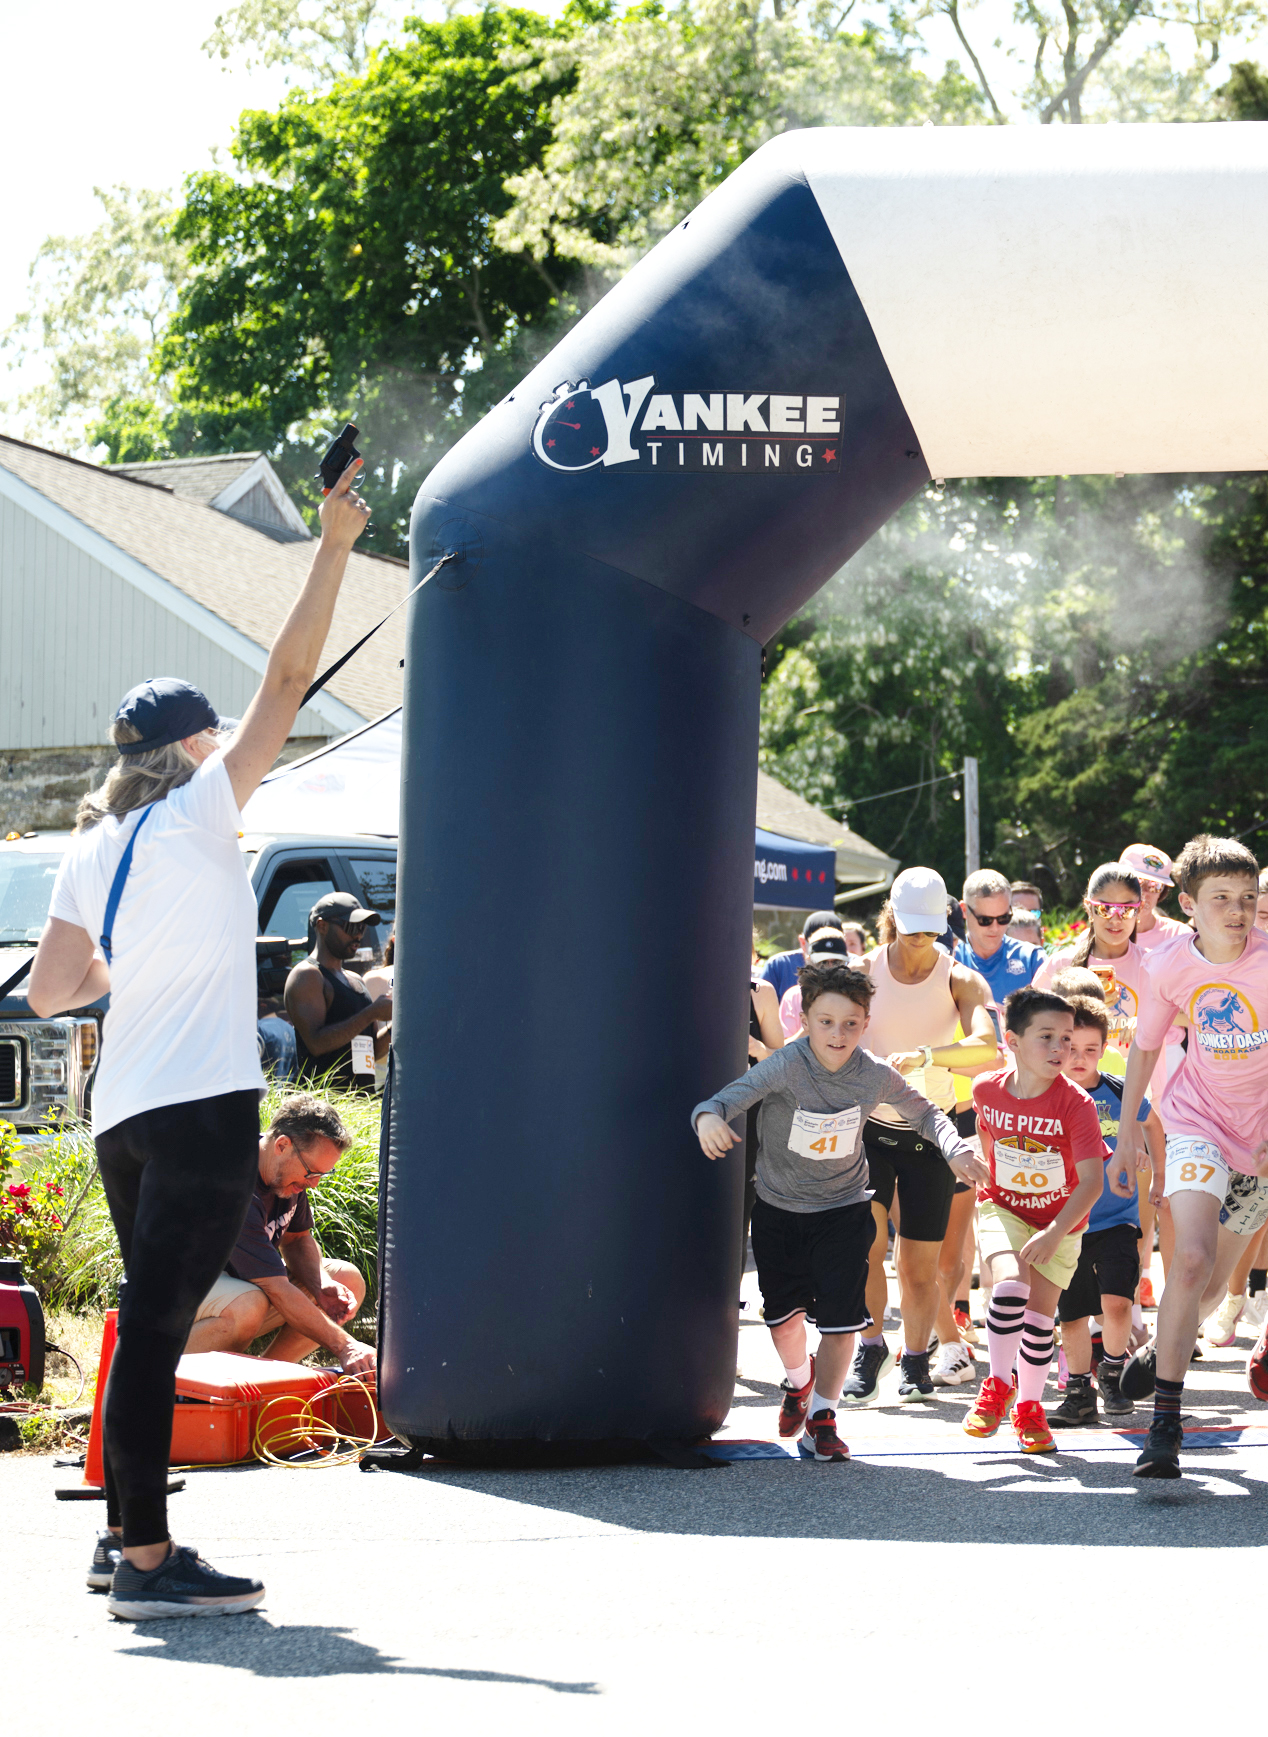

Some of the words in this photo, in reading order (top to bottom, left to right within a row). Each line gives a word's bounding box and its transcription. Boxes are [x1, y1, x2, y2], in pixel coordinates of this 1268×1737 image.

[592, 375, 840, 466] YANKEE
[647, 443, 812, 467] TIMING
[983, 1105, 1014, 1131] GIVE
[1017, 1115, 1063, 1136] PIZZA
[810, 1135, 838, 1154] 41
[1011, 1172, 1048, 1188] 40
[1180, 1162, 1216, 1184] 87
